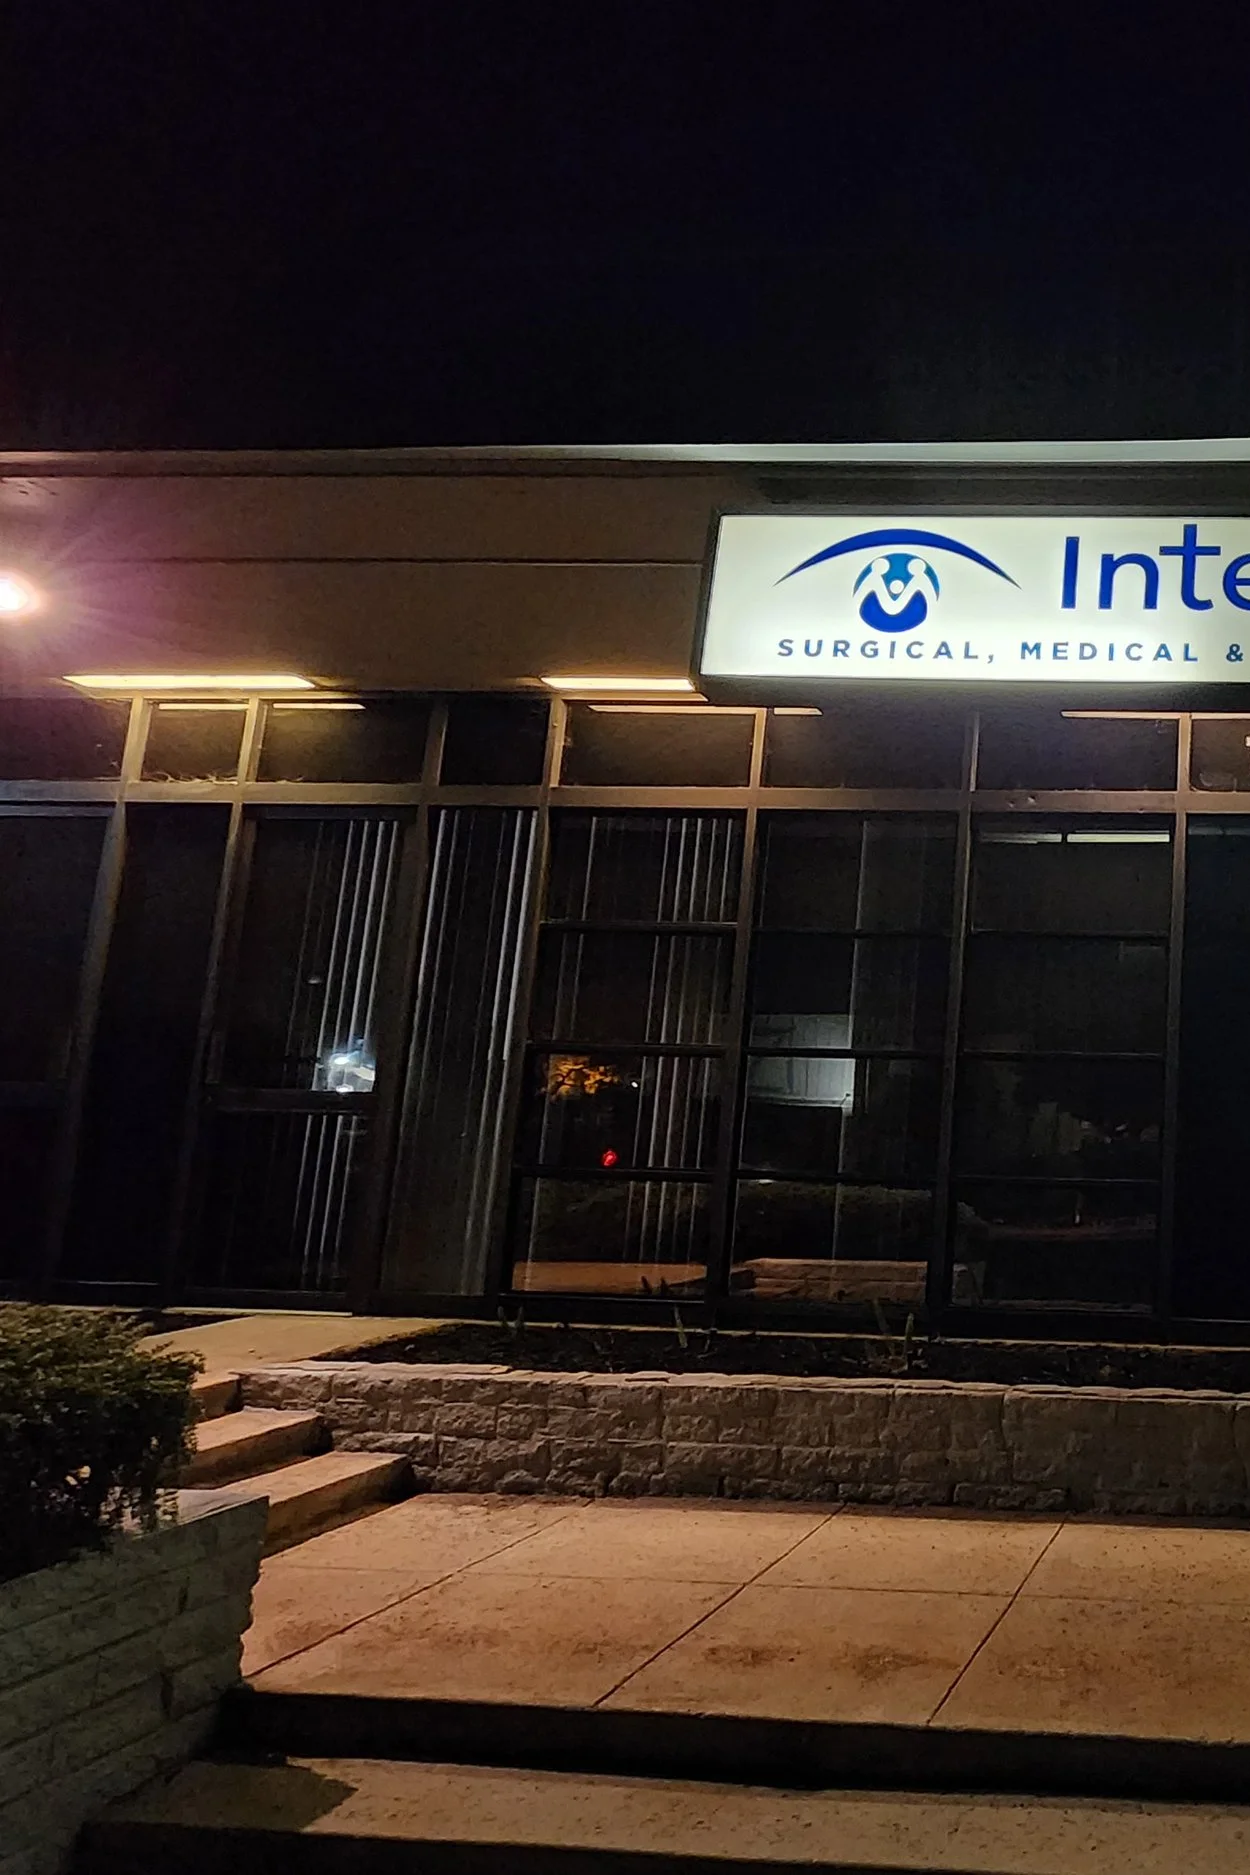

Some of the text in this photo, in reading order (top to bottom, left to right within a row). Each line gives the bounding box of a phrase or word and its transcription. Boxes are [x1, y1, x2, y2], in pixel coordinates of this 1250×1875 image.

[777, 639, 996, 666] SURGICAL,
[1020, 642, 1199, 663] MEDICAL
[1225, 643, 1244, 663] &
